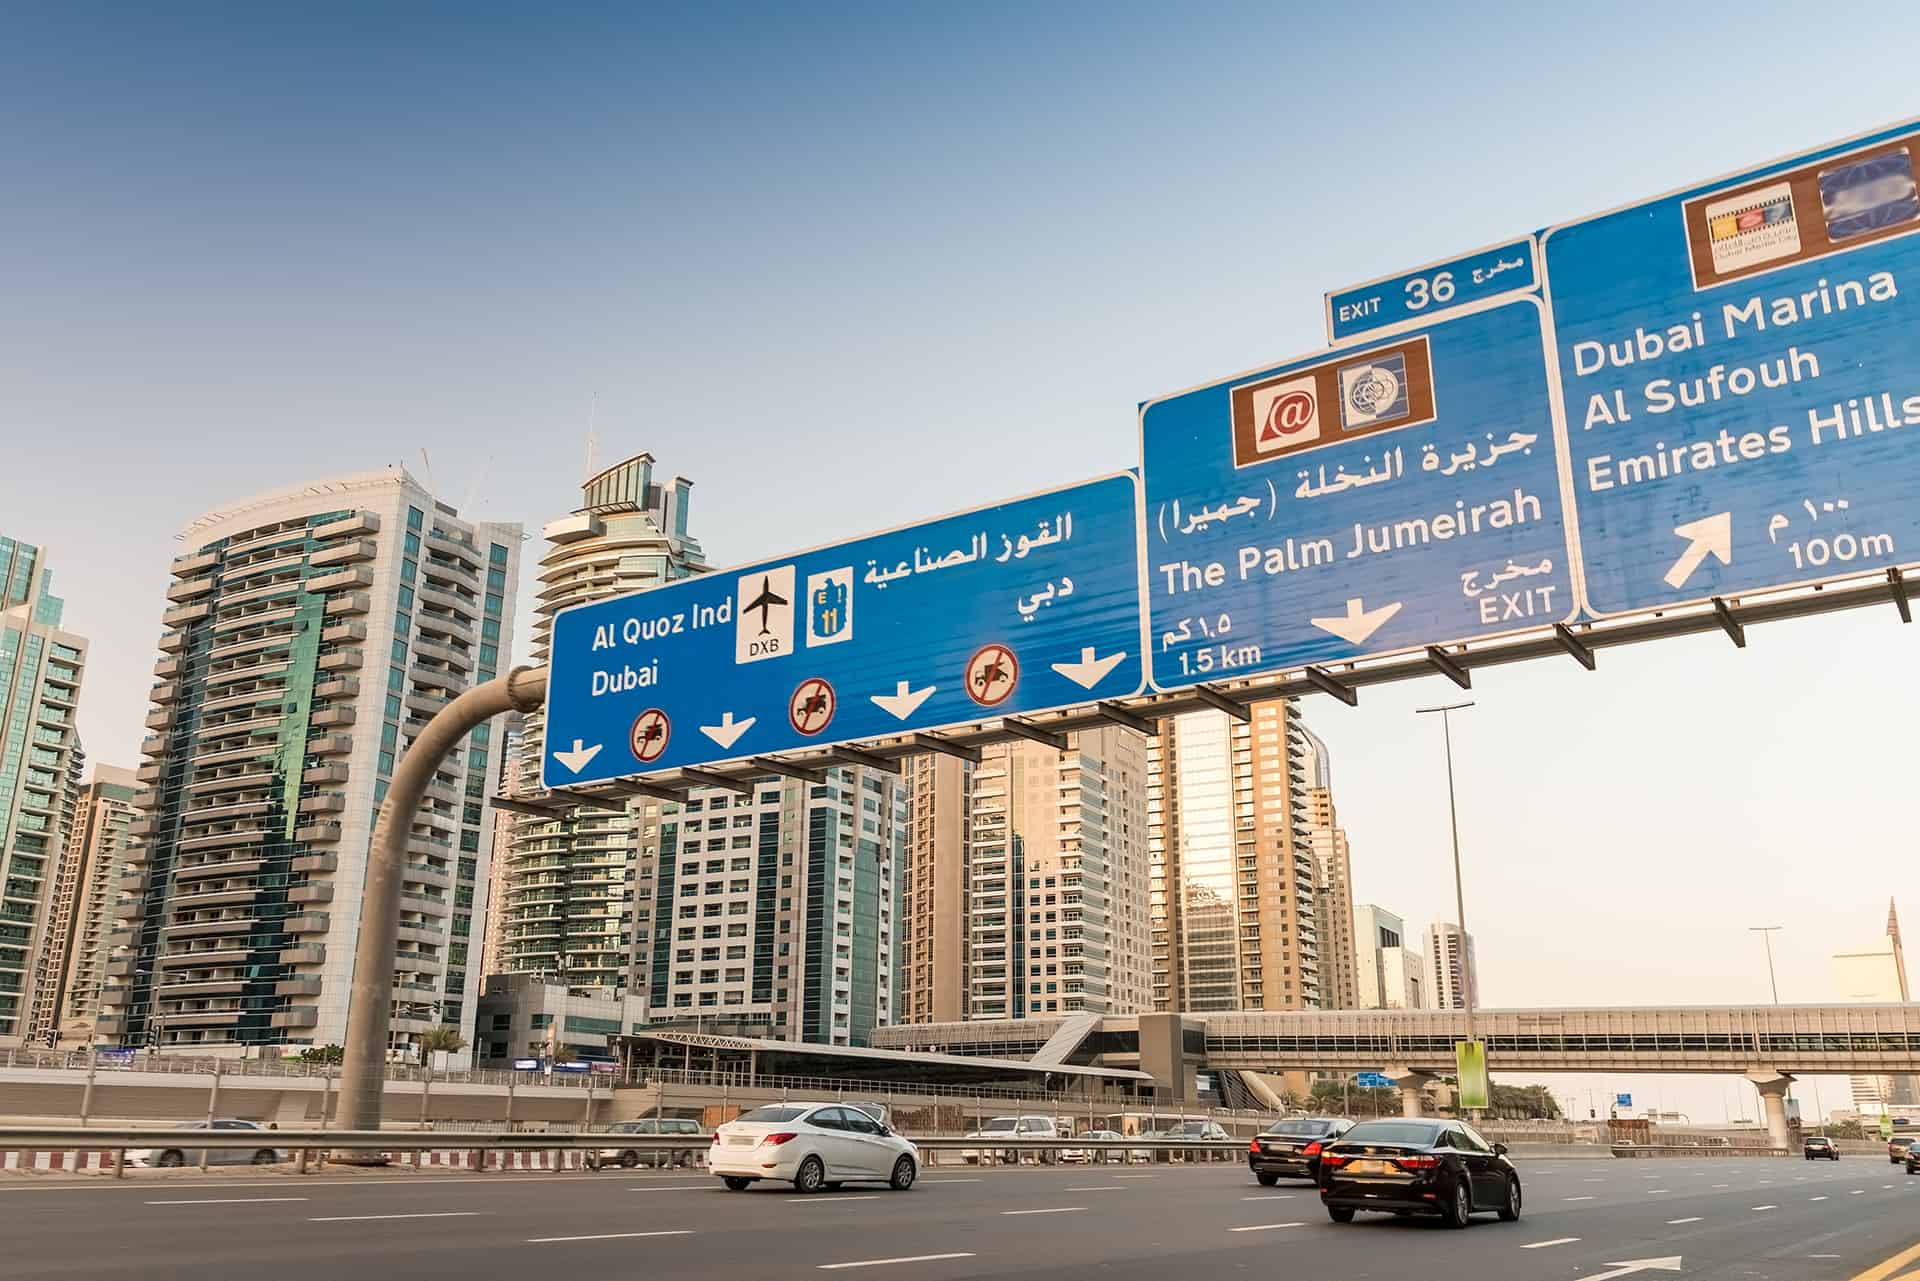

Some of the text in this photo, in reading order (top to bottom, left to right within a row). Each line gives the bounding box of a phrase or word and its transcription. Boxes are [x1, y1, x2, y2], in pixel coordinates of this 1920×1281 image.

[1472, 255, 1523, 284] مخرج
[1340, 271, 1456, 321] EXIT 36
[1573, 270, 1898, 376] Dubai Marina
[1584, 347, 1820, 430] Al Sufouh
[1422, 431, 1537, 475] جزيرة
[1586, 392, 1920, 491] Emirates Hills
[1295, 446, 1403, 499] النخلة
[863, 513, 1072, 587] القوز الصناعية
[1159, 488, 1542, 595] The Palm Jumeirah
[818, 591, 827, 605] E
[1018, 576, 1074, 621] دبي
[1461, 556, 1553, 597] مخرج
[592, 596, 732, 651] Al Quoz Ind
[822, 608, 838, 634] 11
[1479, 586, 1556, 625] EXIT
[749, 638, 780, 657] DXB
[1162, 617, 1192, 653] كم
[592, 659, 658, 697] Dubai
[1179, 644, 1262, 676] 1.5 km
